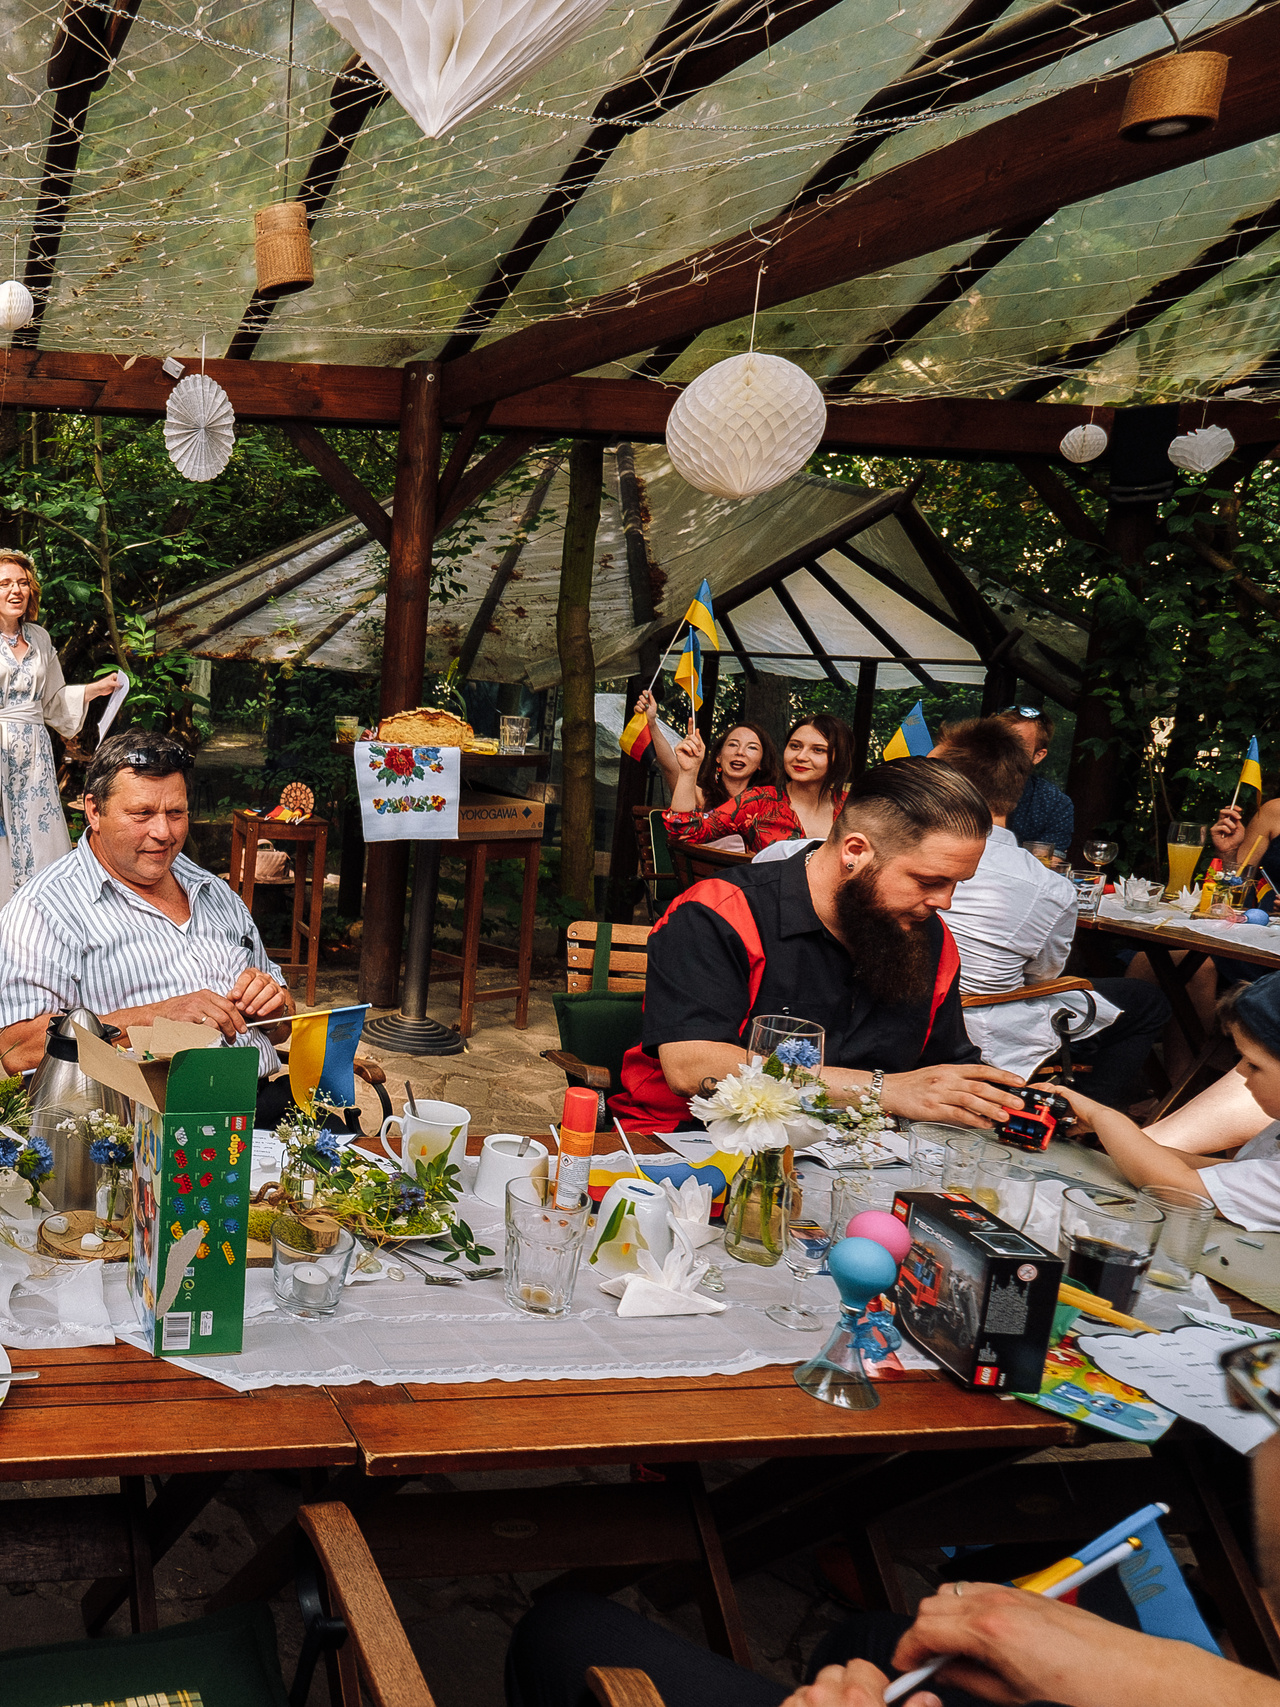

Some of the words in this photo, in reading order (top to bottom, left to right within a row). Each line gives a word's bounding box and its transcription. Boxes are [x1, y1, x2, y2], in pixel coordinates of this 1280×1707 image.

[459, 808, 518, 820] YOKOGAWA
[227, 1133, 241, 1165] duplo
[914, 1217, 954, 1249] TECHNIC
[981, 1367, 991, 1384] LEGO
